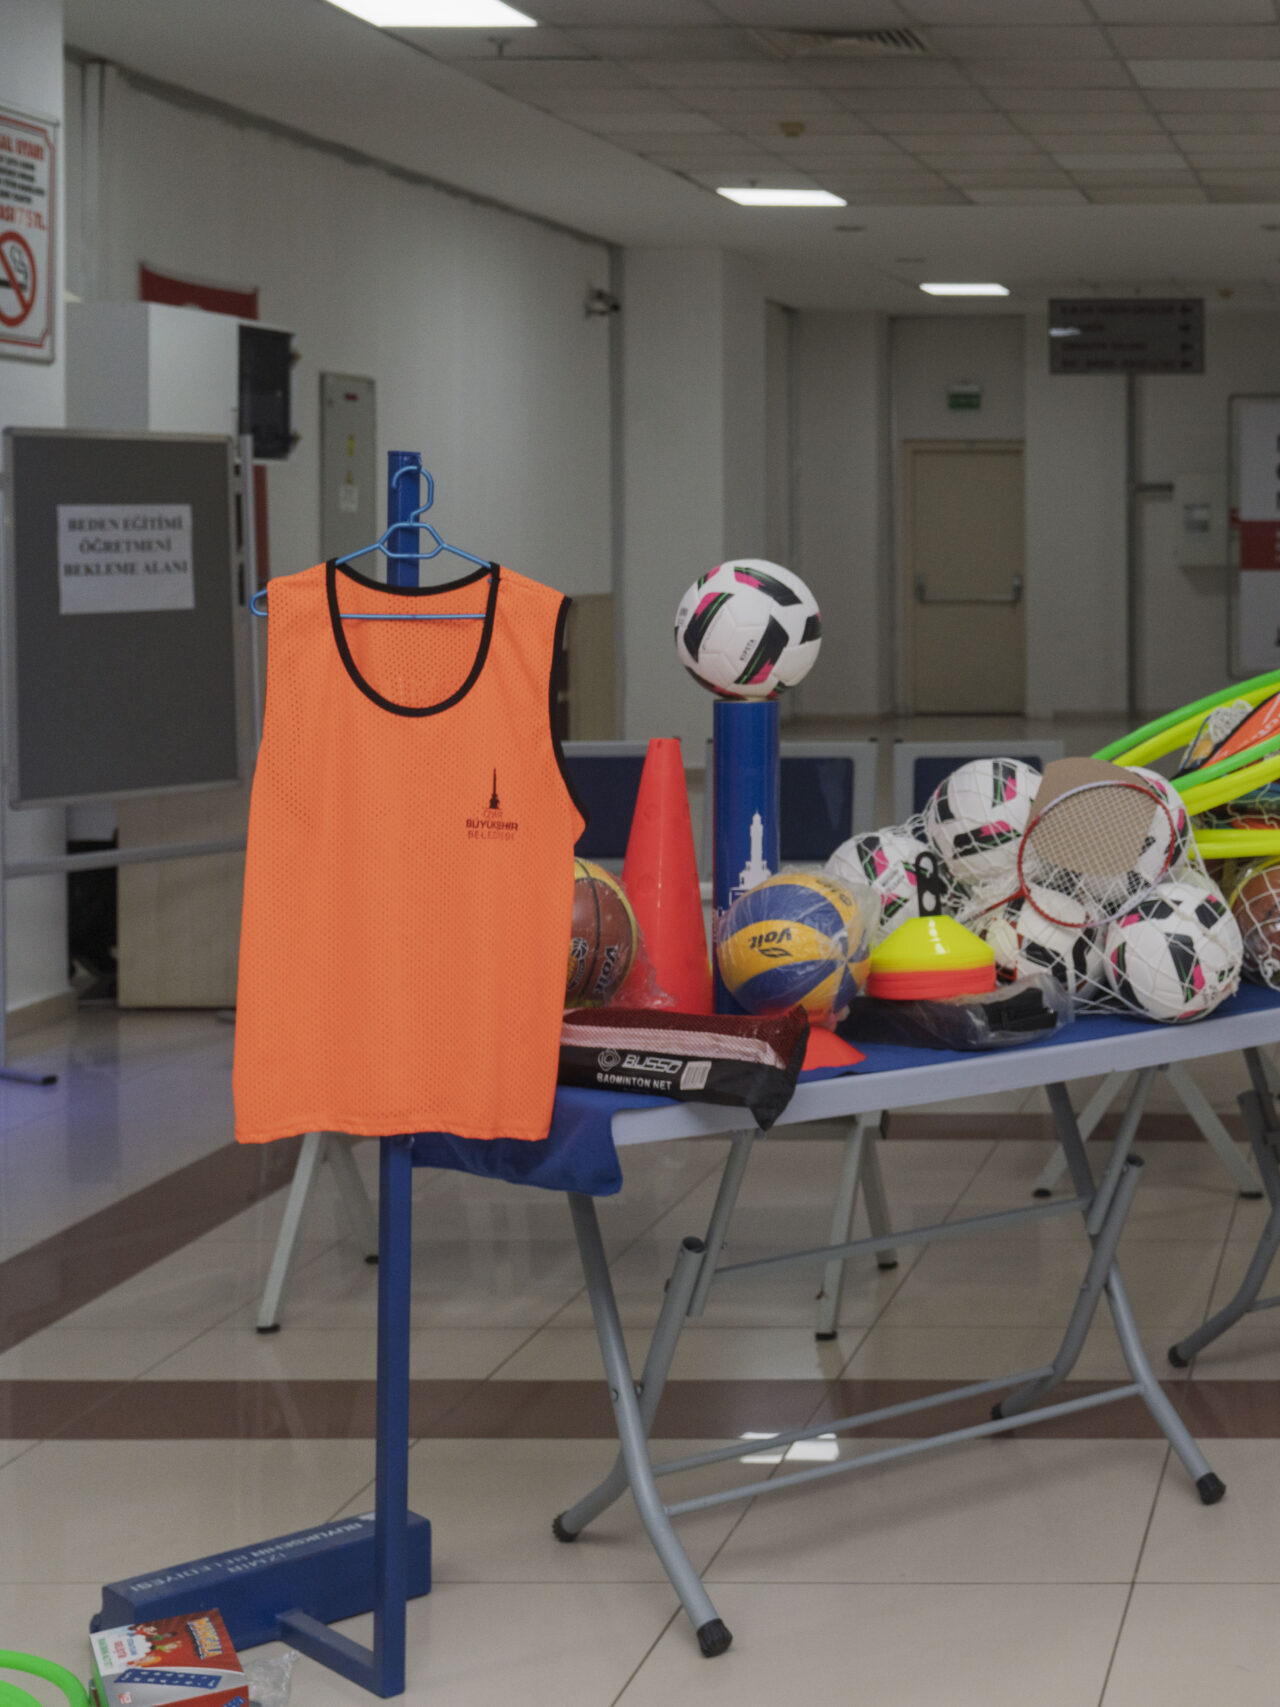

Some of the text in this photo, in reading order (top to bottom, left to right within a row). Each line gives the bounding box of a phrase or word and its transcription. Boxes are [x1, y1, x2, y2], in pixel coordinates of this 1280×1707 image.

[67, 517, 119, 532] BEDEN
[63, 560, 188, 577] BEKLEME ALANI
[621, 1053, 684, 1075] BUSSO
[596, 1072, 673, 1091] BADMINTON NET
